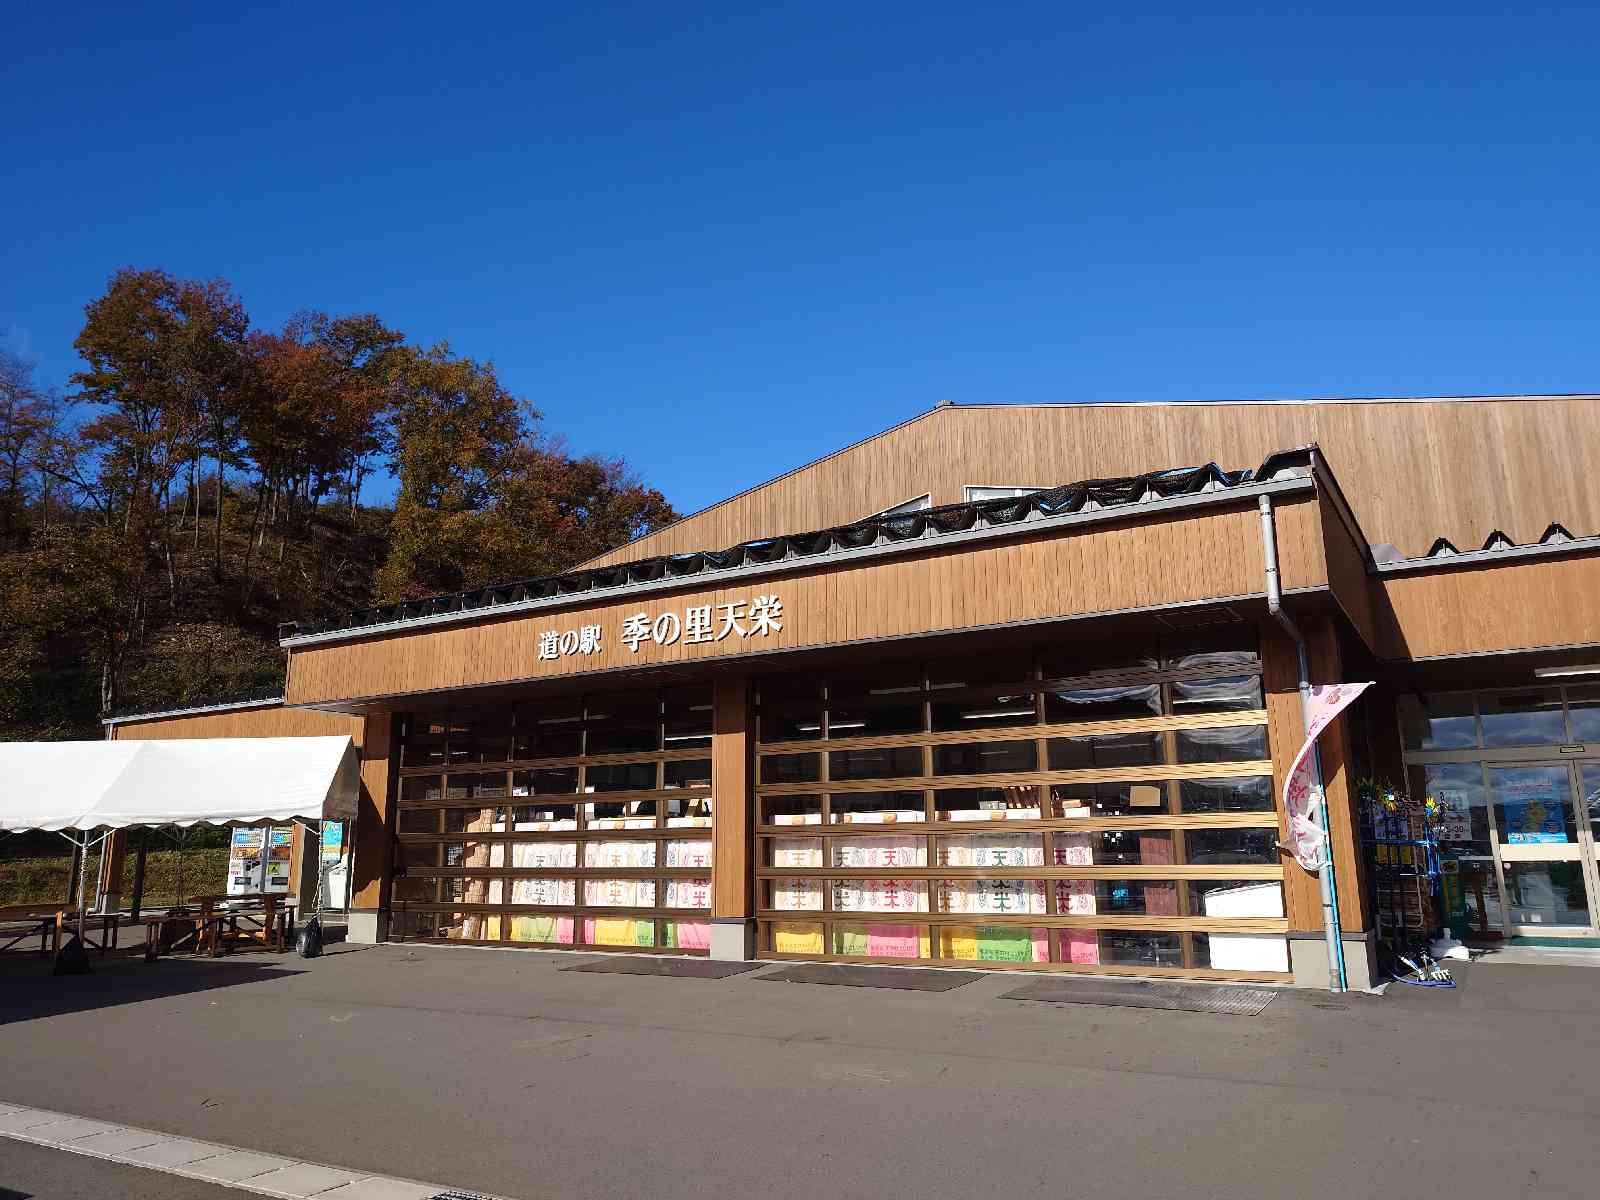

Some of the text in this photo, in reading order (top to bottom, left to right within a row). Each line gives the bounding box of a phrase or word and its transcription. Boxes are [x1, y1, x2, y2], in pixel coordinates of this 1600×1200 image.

[538, 595, 783, 662] 道の駅 季の里天栄
